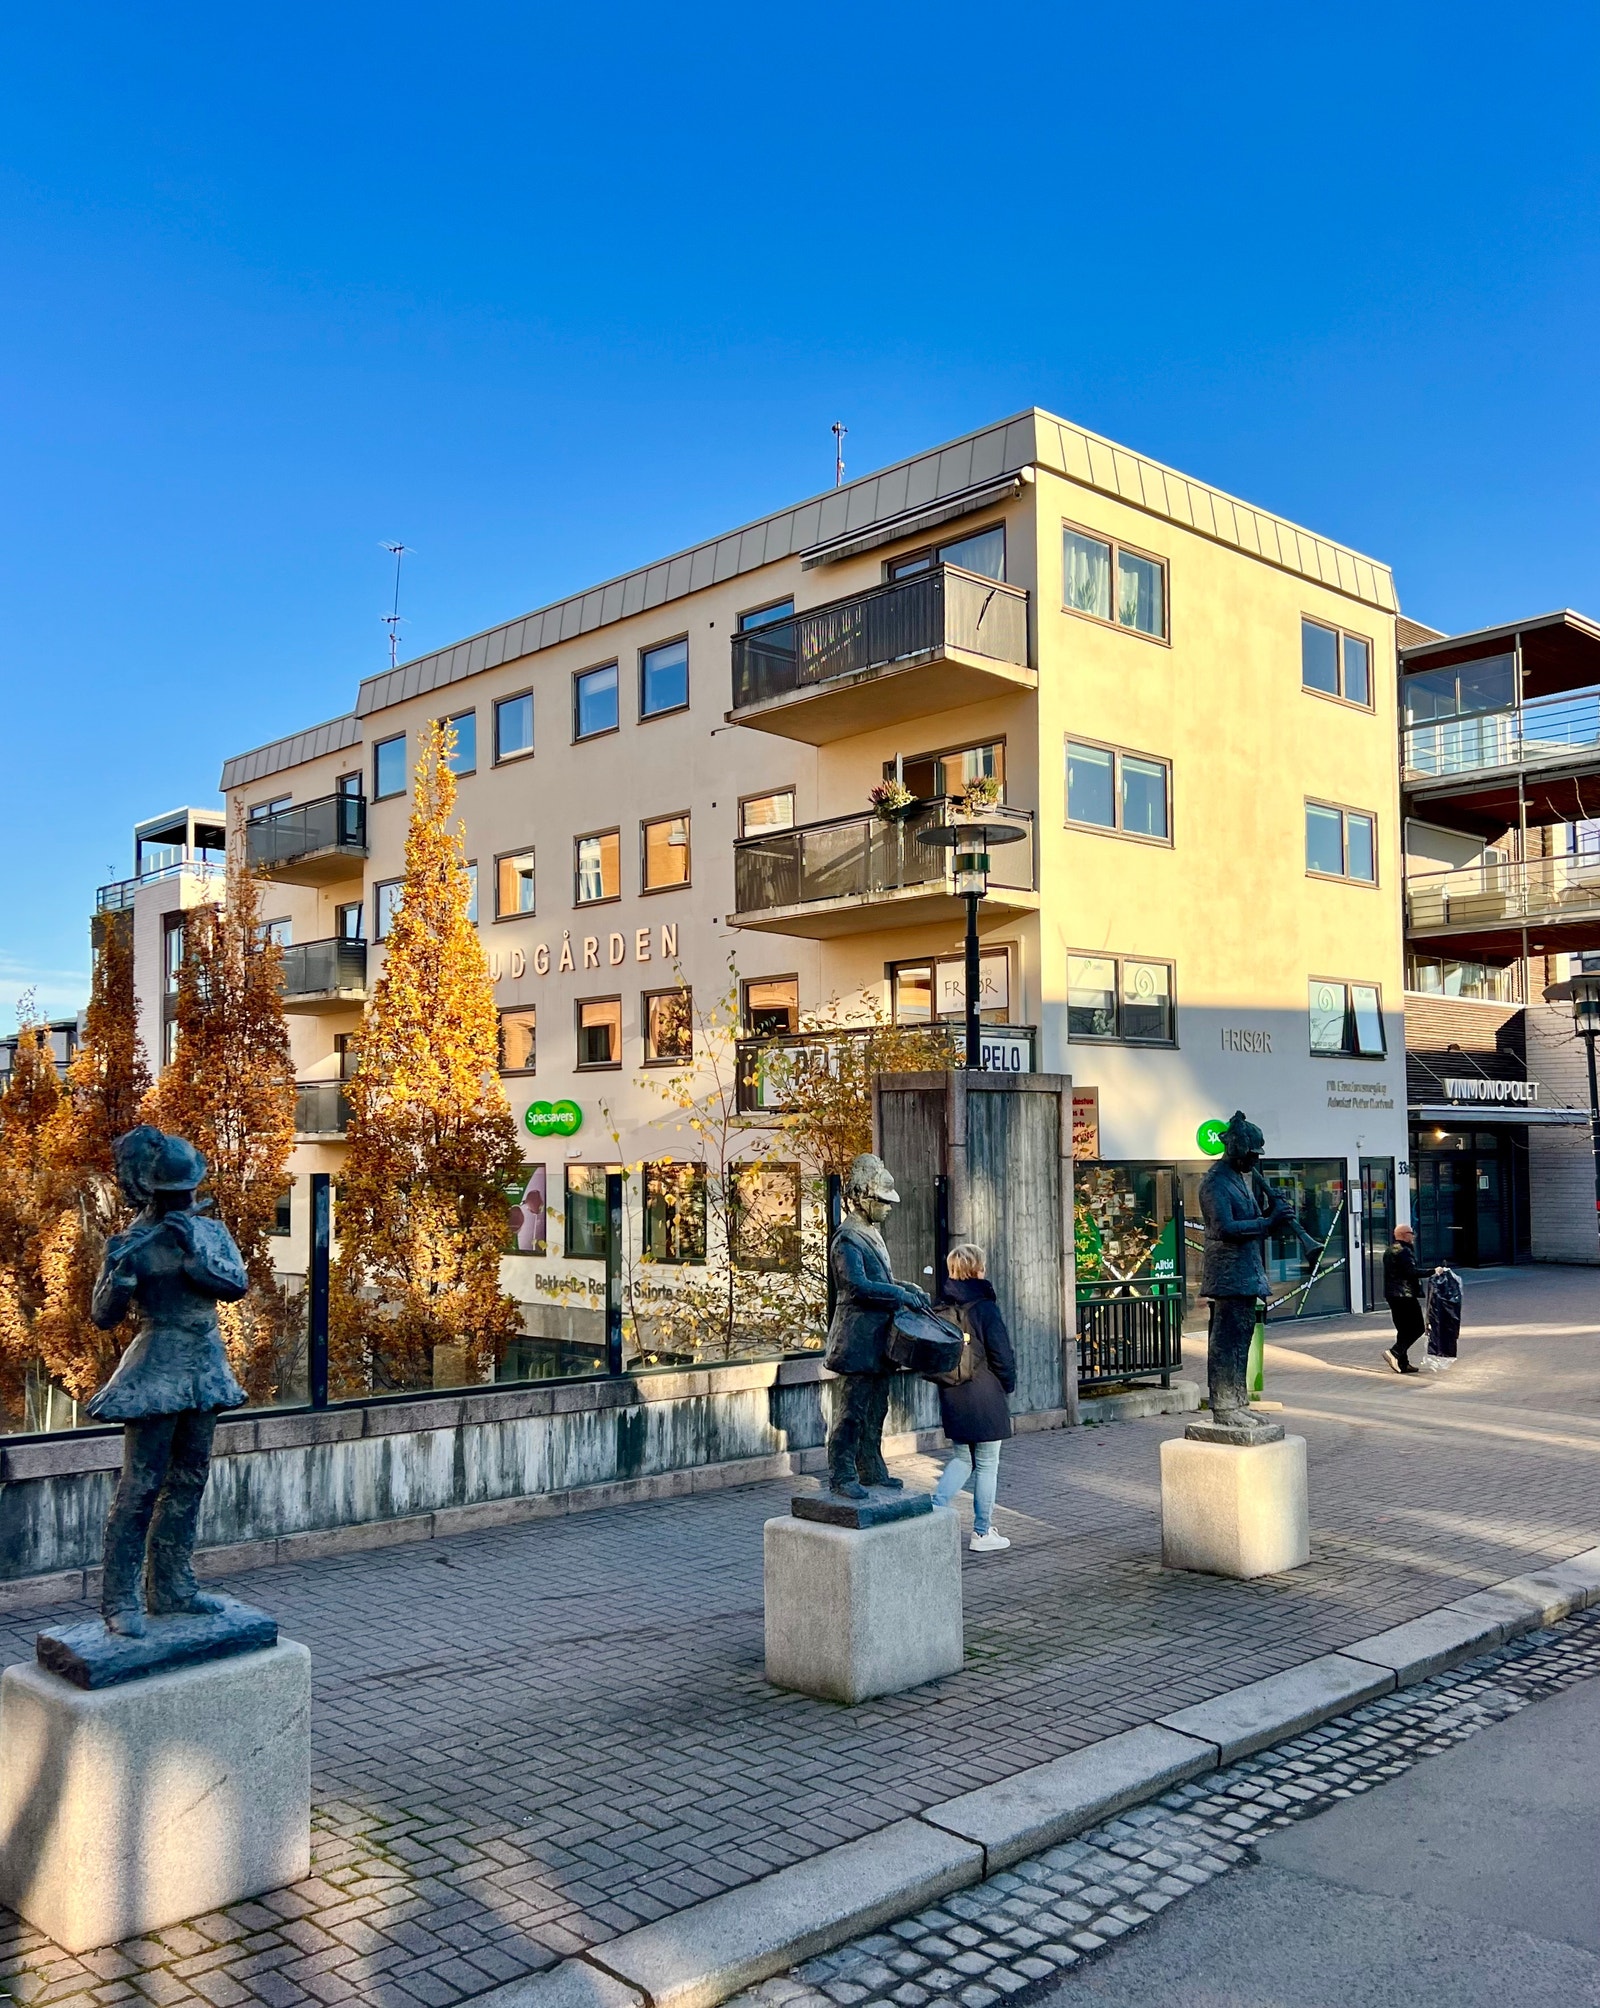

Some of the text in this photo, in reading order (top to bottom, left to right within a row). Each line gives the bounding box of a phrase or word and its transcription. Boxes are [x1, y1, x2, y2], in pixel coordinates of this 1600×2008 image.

[489, 923, 679, 982] UDGÅRDEN
[1221, 1027, 1272, 1053] FRISØR
[982, 1045, 1021, 1072] PELO
[1446, 1078, 1540, 1101] VINMONOPOLET
[528, 1111, 575, 1125] Specsavers
[1079, 1108, 1085, 1117] &
[1155, 1259, 1174, 1271] Alltid
